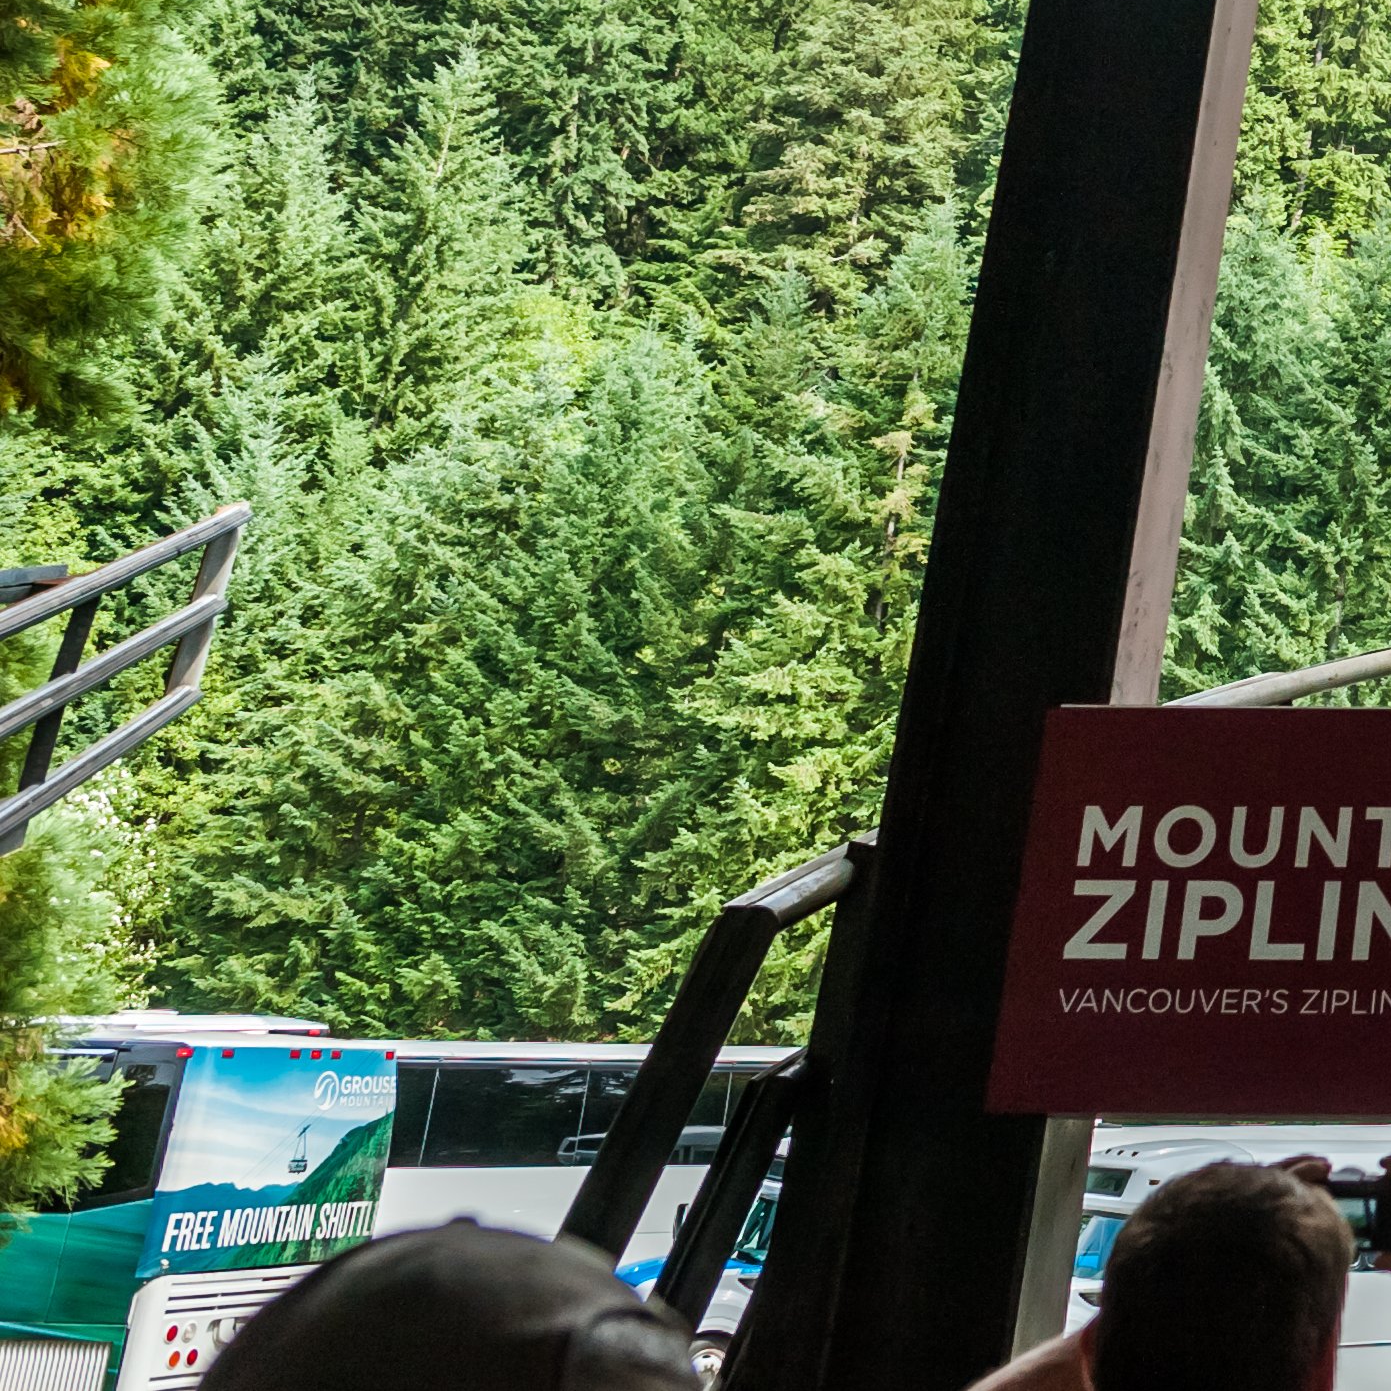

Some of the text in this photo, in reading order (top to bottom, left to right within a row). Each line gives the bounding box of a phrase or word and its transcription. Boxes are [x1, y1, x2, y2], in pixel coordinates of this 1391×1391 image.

[1058, 987, 1289, 1015] VANCOUVER'S
[341, 1075, 397, 1095] GROUSE
[161, 1210, 219, 1252] FREE
[216, 1203, 318, 1249] MOUNTAIN
